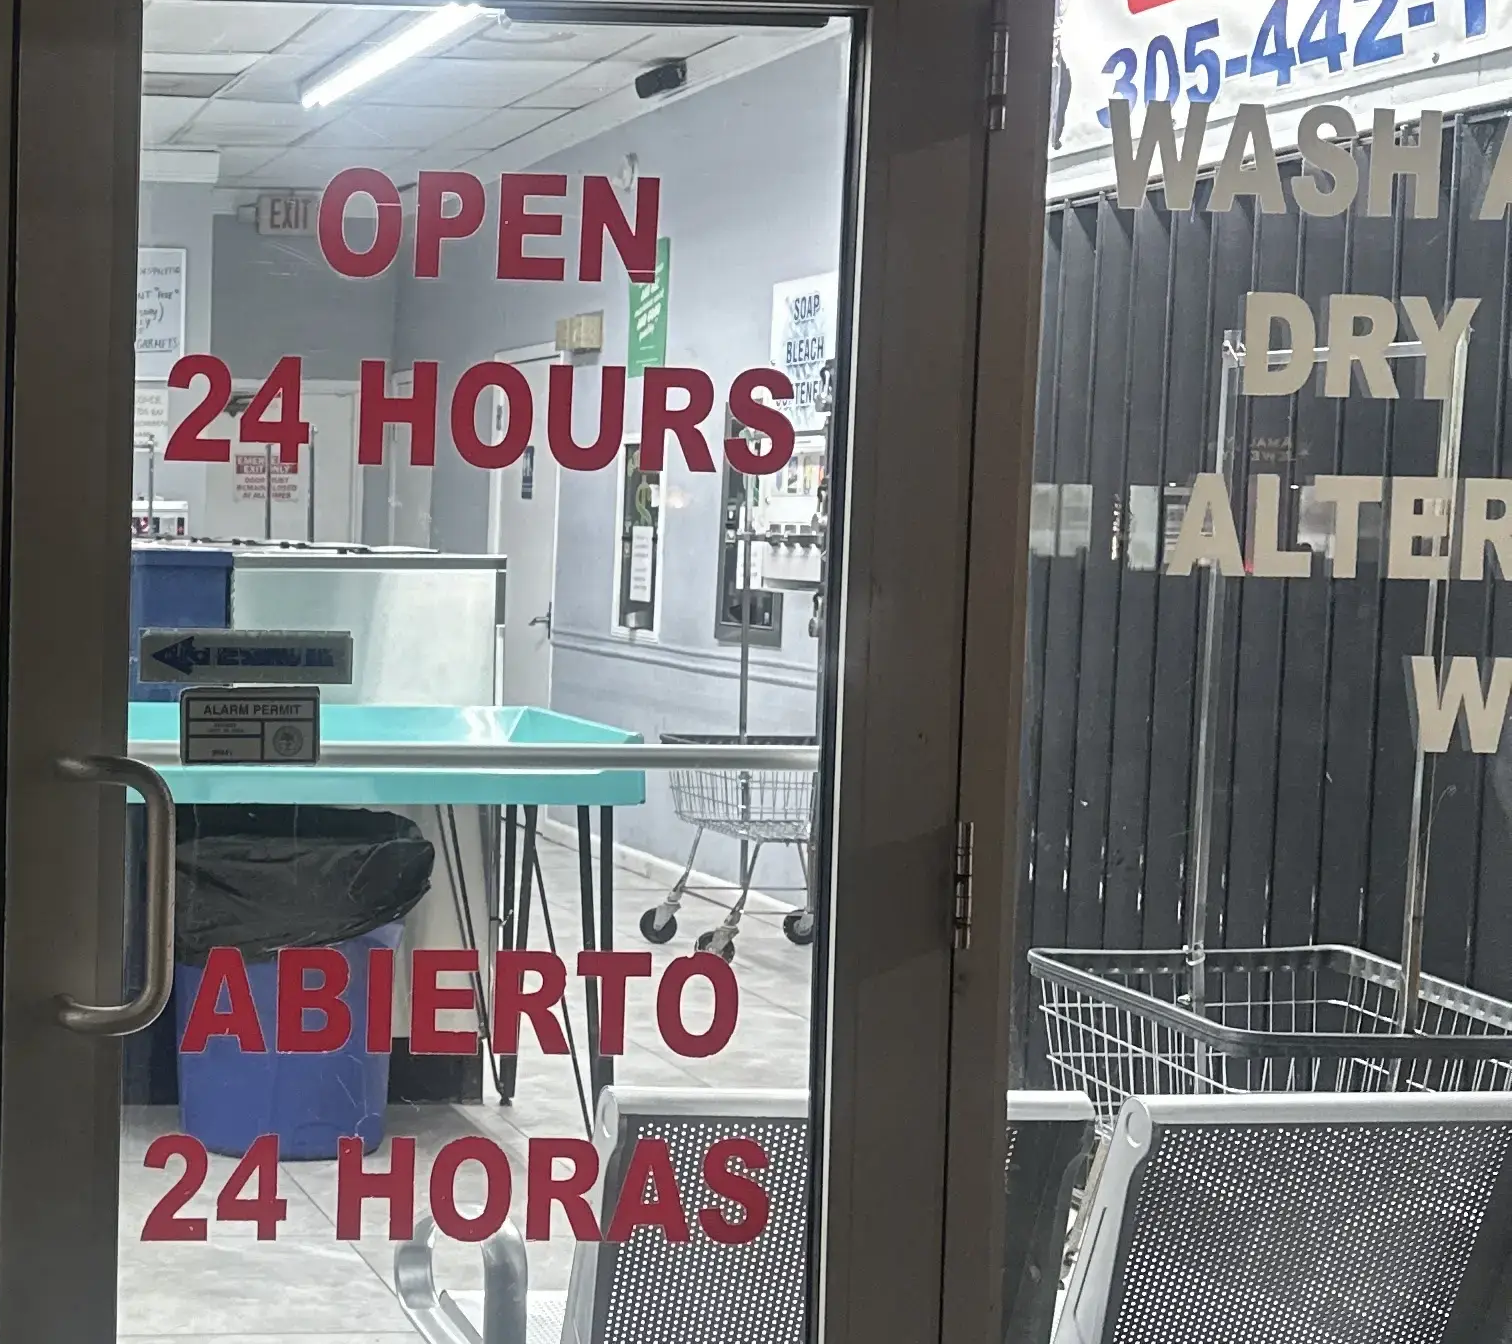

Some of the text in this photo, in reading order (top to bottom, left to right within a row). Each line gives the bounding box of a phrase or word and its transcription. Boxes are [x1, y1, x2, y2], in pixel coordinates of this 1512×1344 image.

[269, 198, 312, 230] EXIT
[1108, 97, 1444, 221] WASH
[317, 167, 660, 283] OPEN
[785, 335, 825, 364] BLEACH
[793, 293, 821, 322] SOAP
[1243, 291, 1483, 401] DRY
[164, 353, 310, 465] 24
[358, 359, 796, 476] HOURS
[203, 704, 302, 716] ALARM PERMIT
[179, 945, 740, 1059] ABIERTO
[141, 1133, 771, 1244] 24 HORAS
